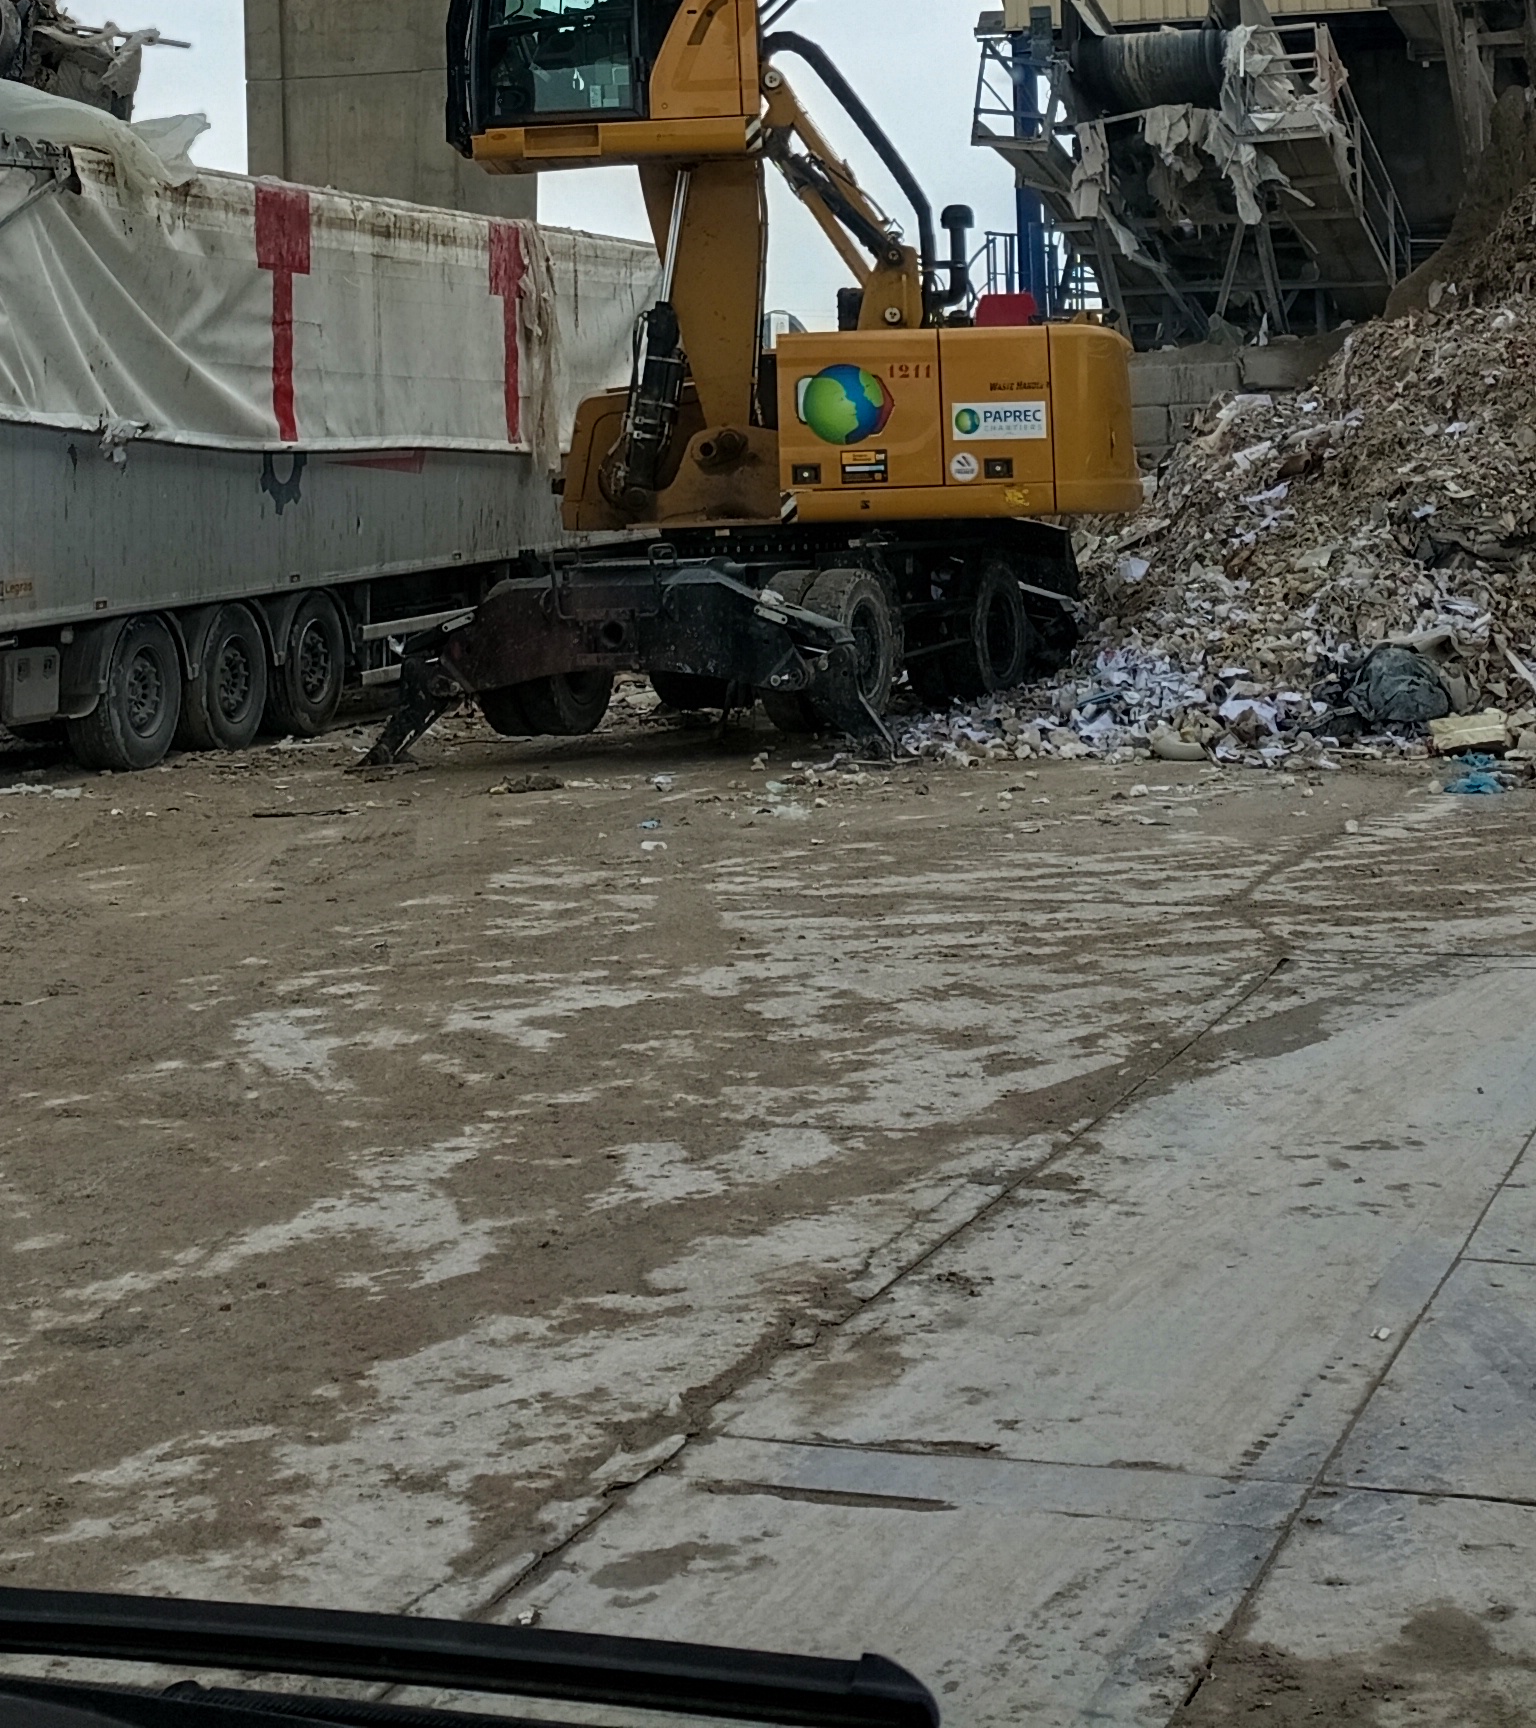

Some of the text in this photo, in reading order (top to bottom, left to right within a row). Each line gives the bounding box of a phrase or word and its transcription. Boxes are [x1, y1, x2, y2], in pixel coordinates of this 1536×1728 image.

[889, 364, 931, 379] 1211
[983, 409, 1042, 422] PAPREC
[983, 423, 1043, 432] CHANTIERS
